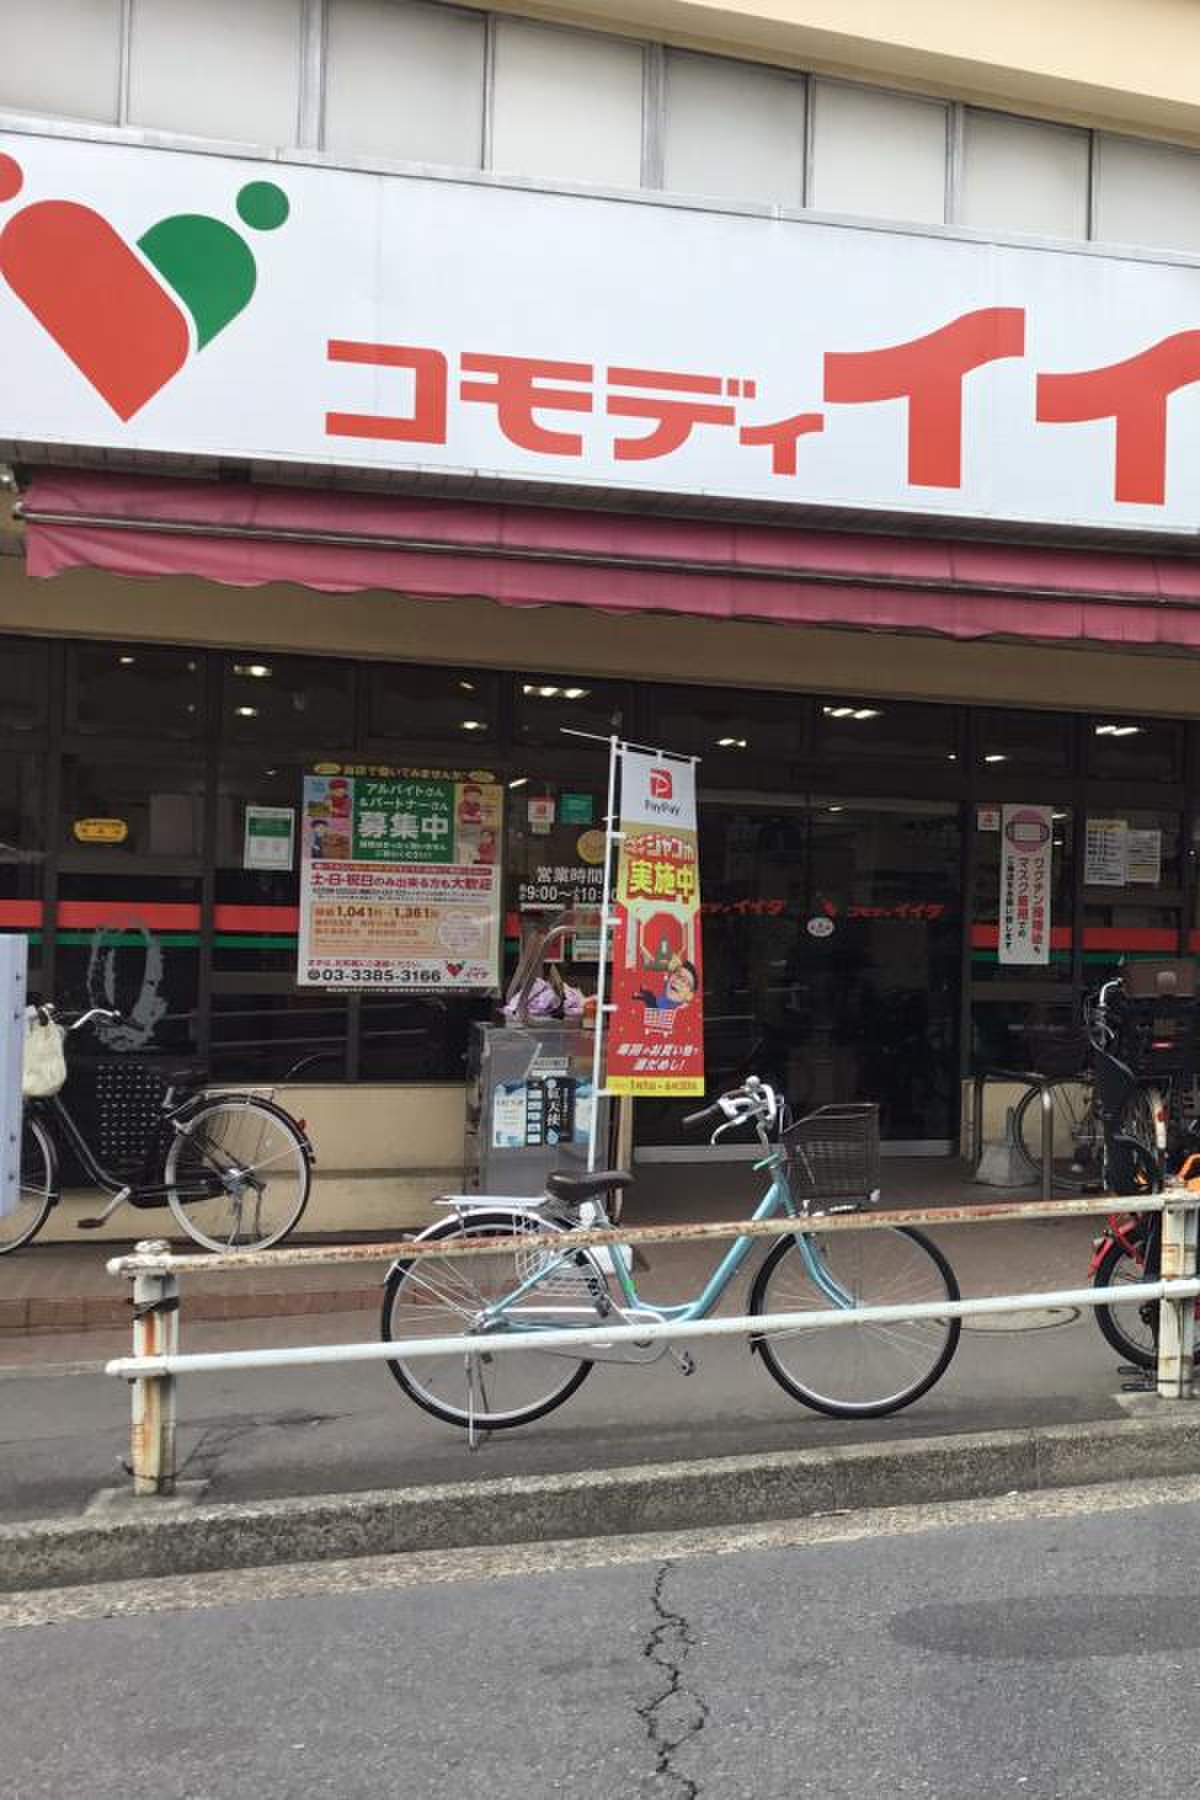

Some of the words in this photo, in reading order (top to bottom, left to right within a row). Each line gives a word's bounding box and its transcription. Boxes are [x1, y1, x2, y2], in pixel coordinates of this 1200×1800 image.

[367, 784, 444, 797] アルバイトさん
[644, 800, 681, 816] PayPay
[358, 811, 449, 841] 募集中
[537, 866, 603, 884] 営業時間
[629, 860, 694, 896] 実施中
[322, 969, 442, 983] 03-3385-3166
